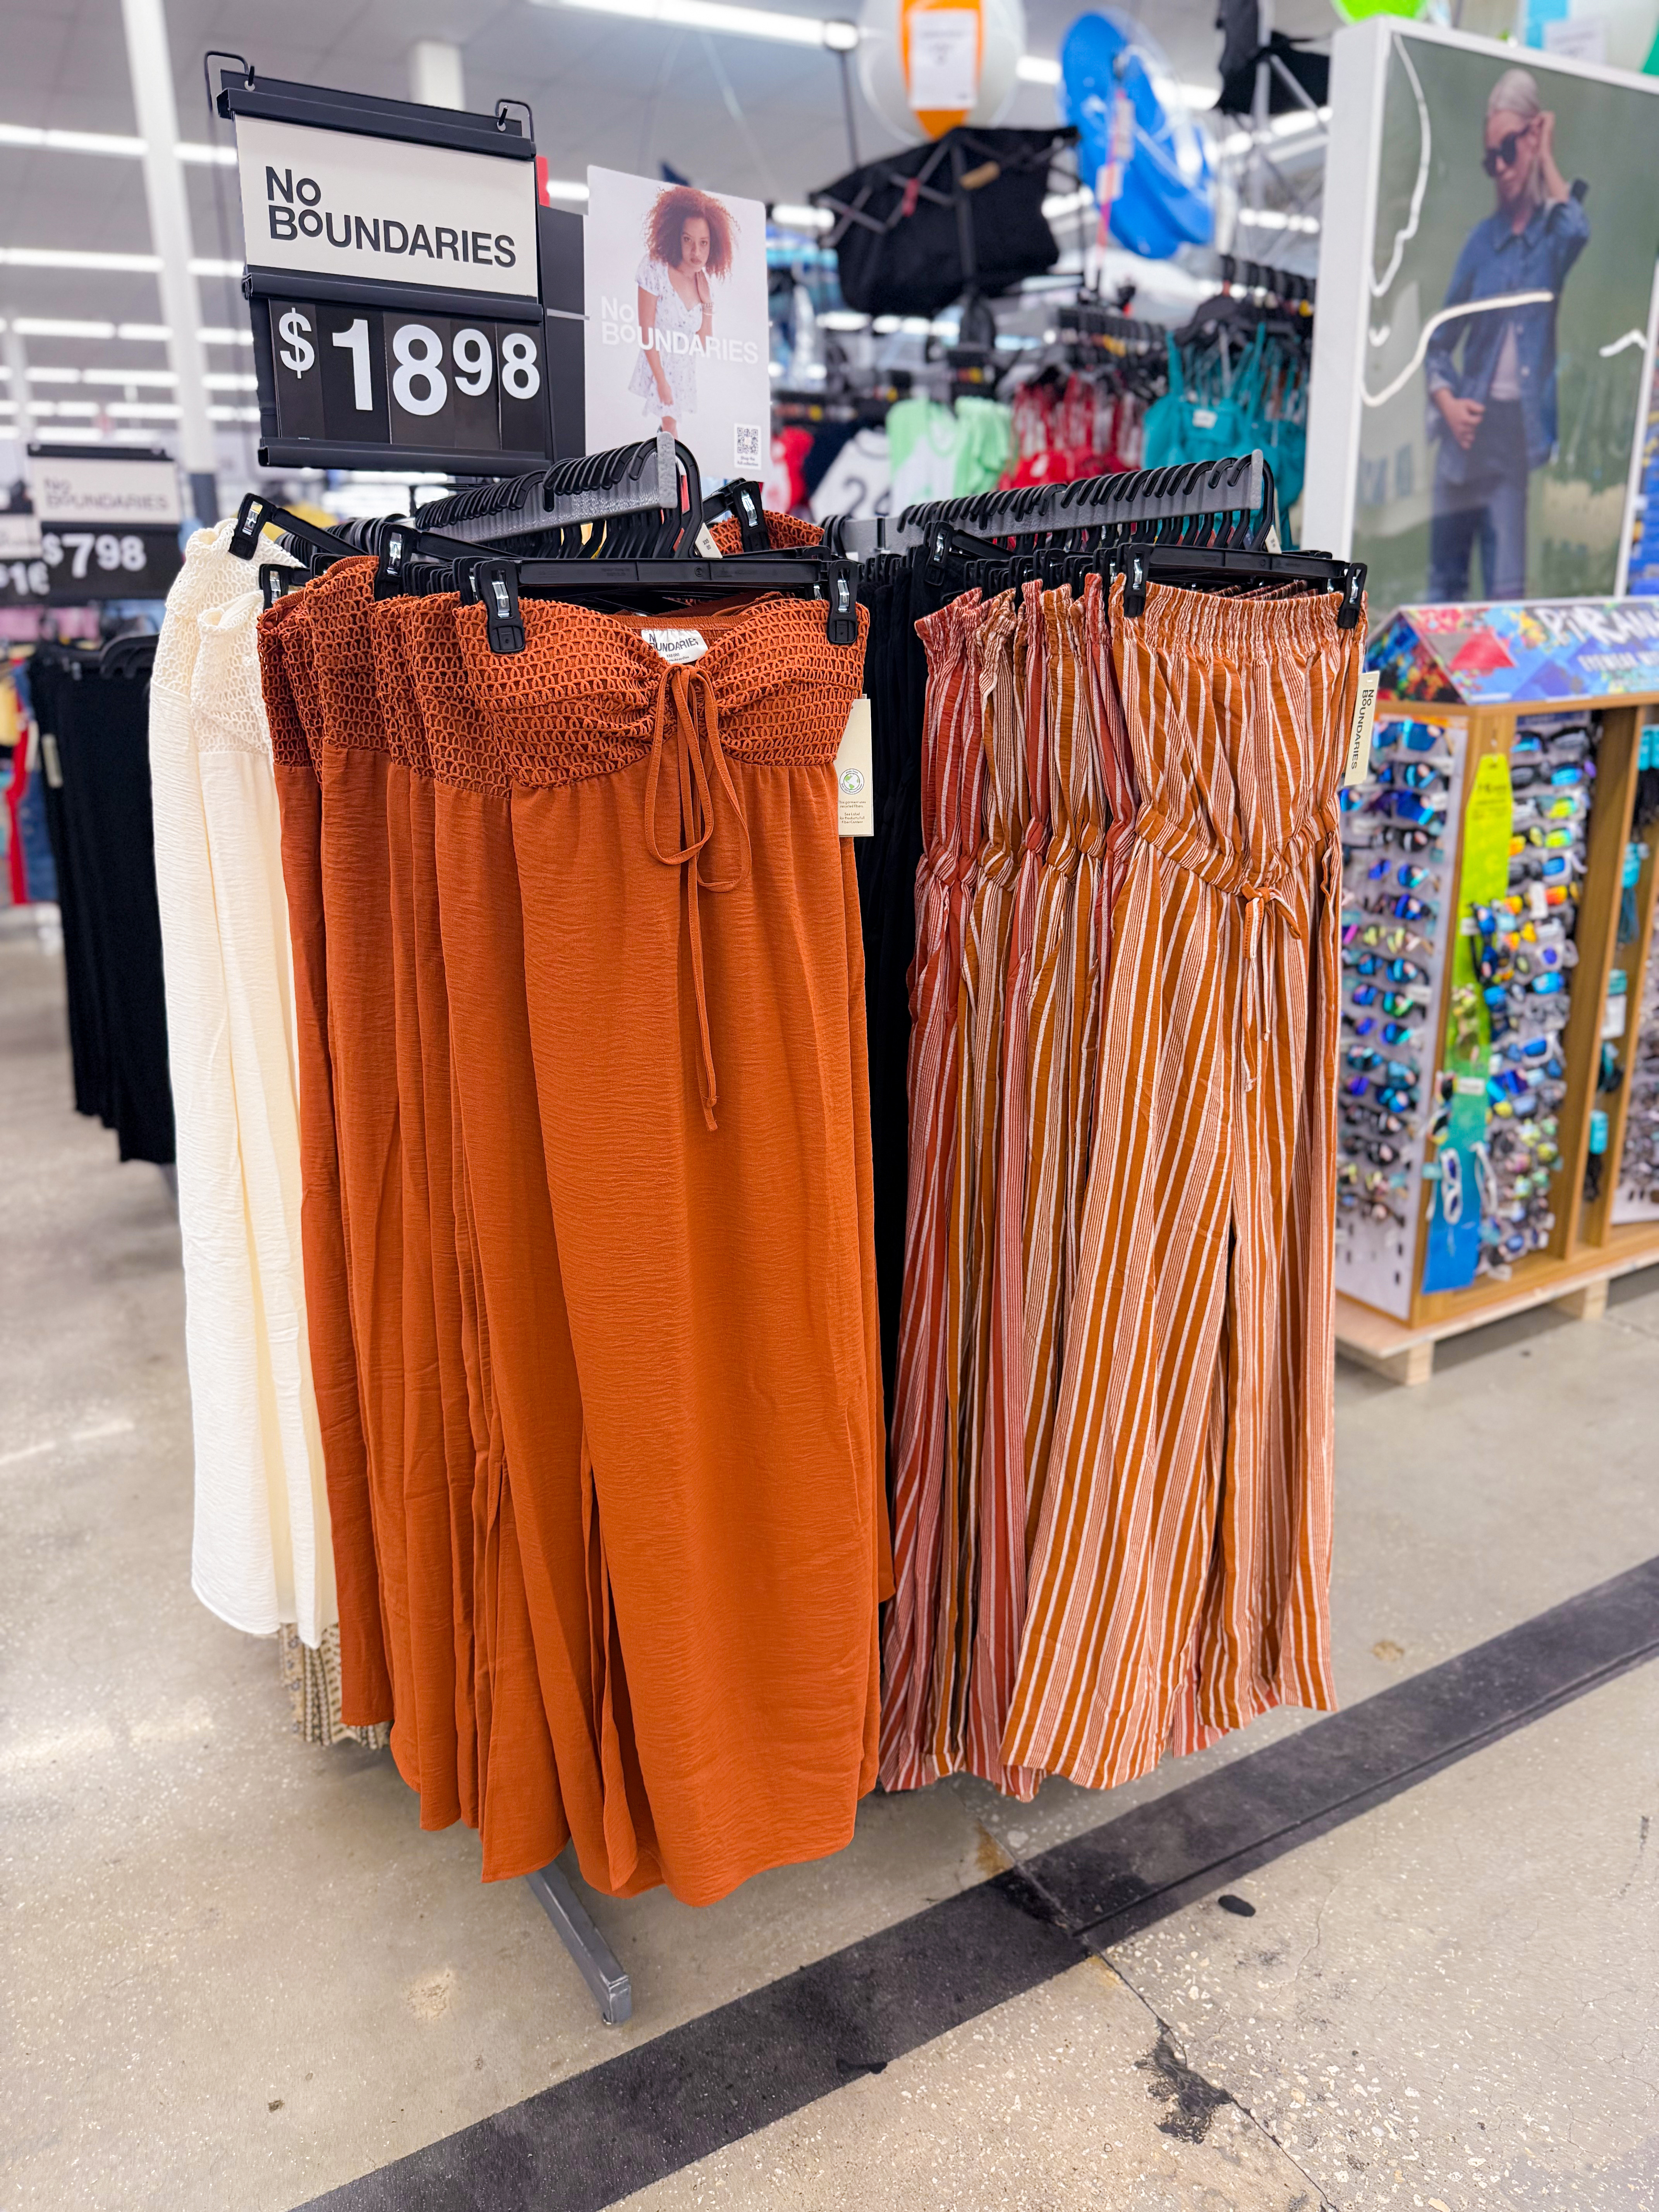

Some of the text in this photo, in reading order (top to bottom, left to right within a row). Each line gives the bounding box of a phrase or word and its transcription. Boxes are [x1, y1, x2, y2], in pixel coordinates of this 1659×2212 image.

[268, 205, 516, 268] BOUNDARIES
[602, 321, 759, 364] BOUNDARIES
[650, 638, 699, 652] UNDARIE
[1351, 690, 1368, 769] BOUNDARIES
